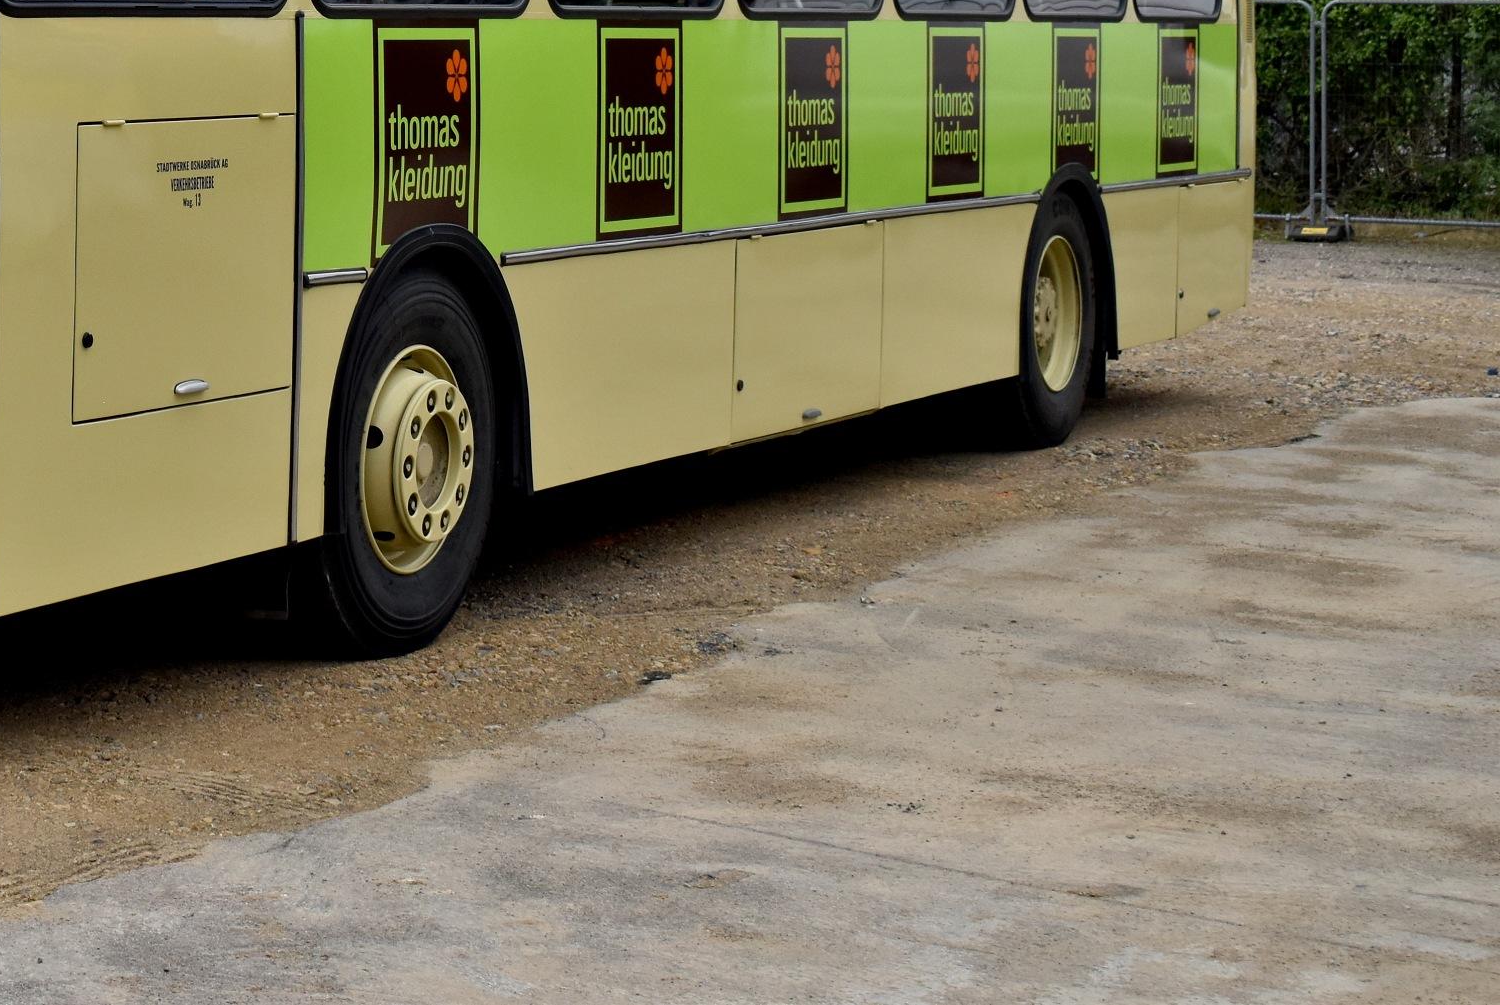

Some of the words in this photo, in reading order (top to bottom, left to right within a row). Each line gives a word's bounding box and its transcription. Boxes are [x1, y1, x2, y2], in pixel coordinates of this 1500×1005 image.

[787, 89, 835, 127] thomas
[934, 84, 974, 117] thomas
[1058, 80, 1091, 111] thomas
[1162, 76, 1191, 106] thomas
[388, 104, 460, 151] thomas
[608, 96, 666, 137] thomas
[1057, 114, 1094, 152] kleidung
[1162, 108, 1193, 143] kleidung
[787, 130, 840, 174] kleidung
[934, 121, 978, 161] kleidung
[156, 161, 190, 173] STADTWERKE
[190, 157, 221, 171] OSNABRÜCK
[221, 158, 229, 168] AG
[388, 154, 467, 208] kleidung
[608, 141, 672, 189] kleidung
[195, 193, 201, 207] 13
